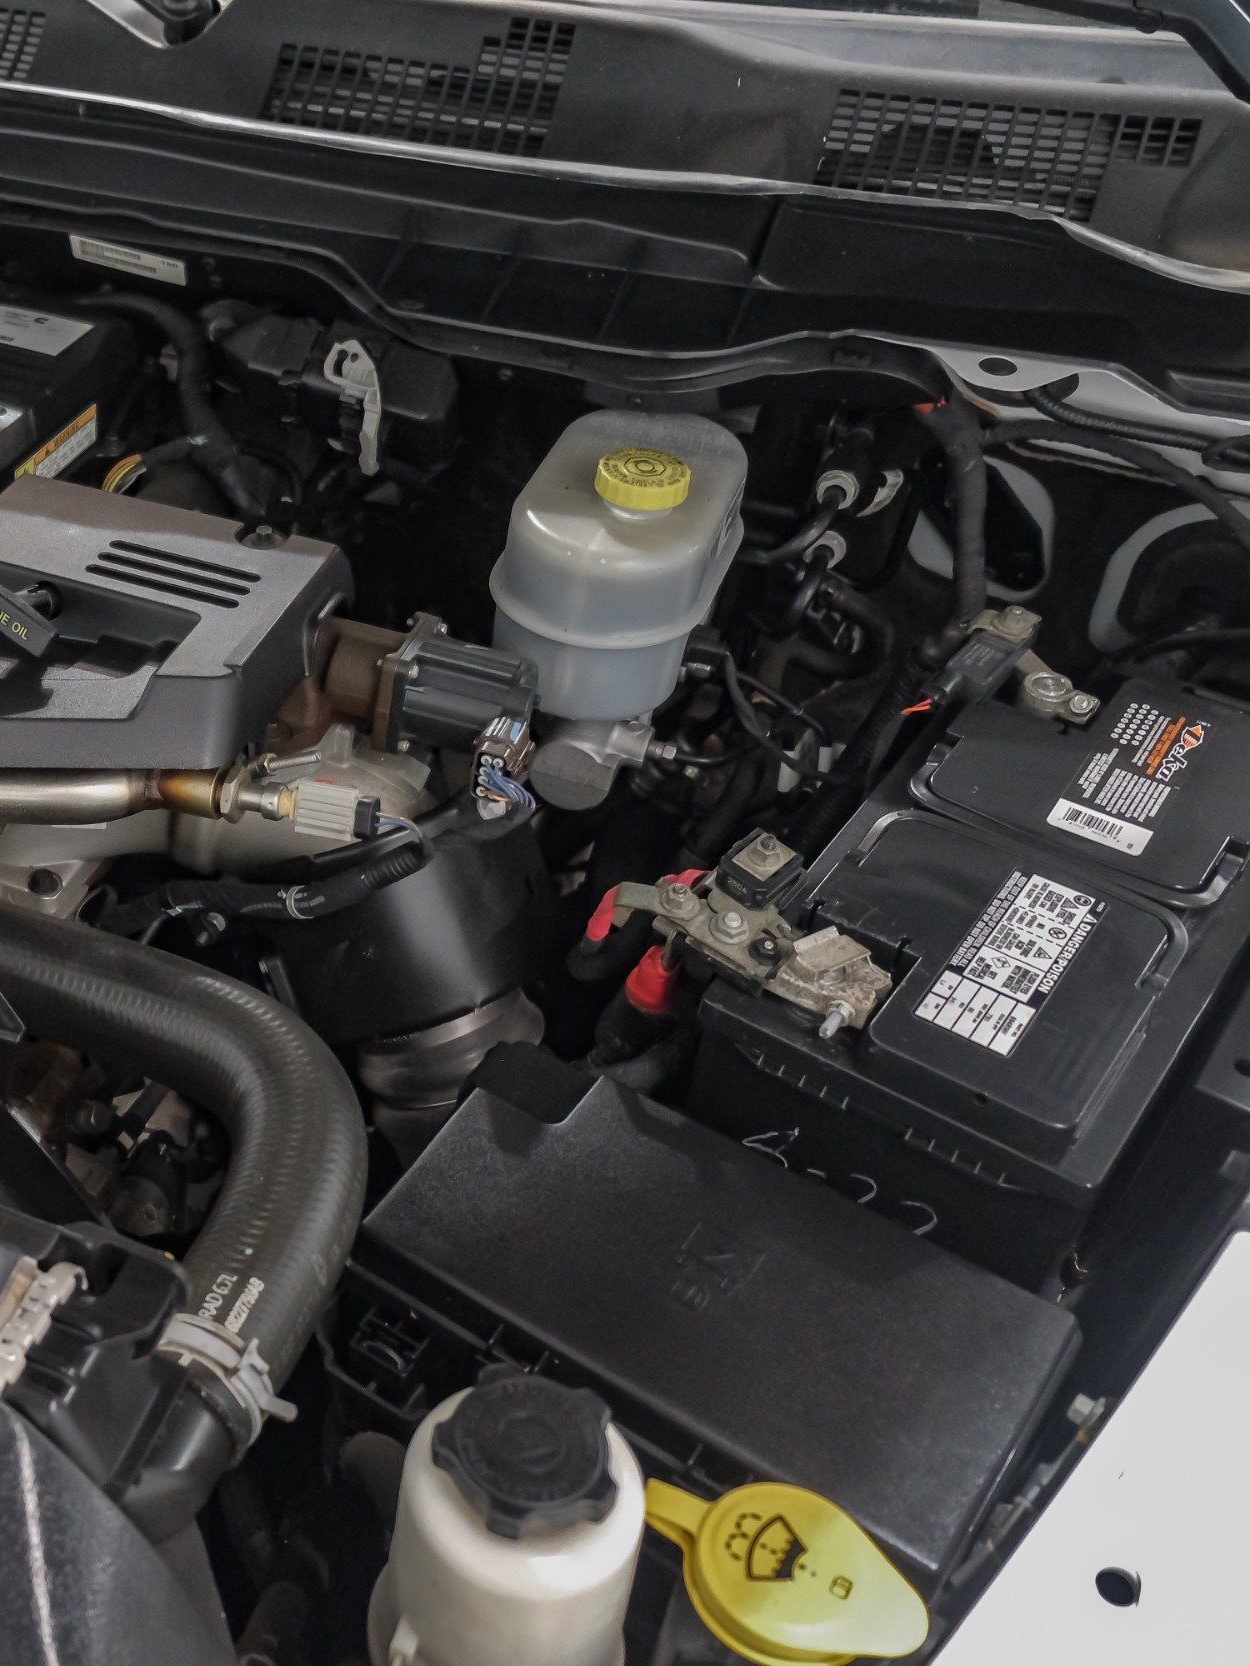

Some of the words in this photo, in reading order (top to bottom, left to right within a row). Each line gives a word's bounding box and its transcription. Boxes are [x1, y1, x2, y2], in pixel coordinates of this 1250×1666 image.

[11, 622, 28, 640] OIL
[1155, 724, 1205, 782] Deka
[1037, 922, 1092, 994] DANGER/POISON
